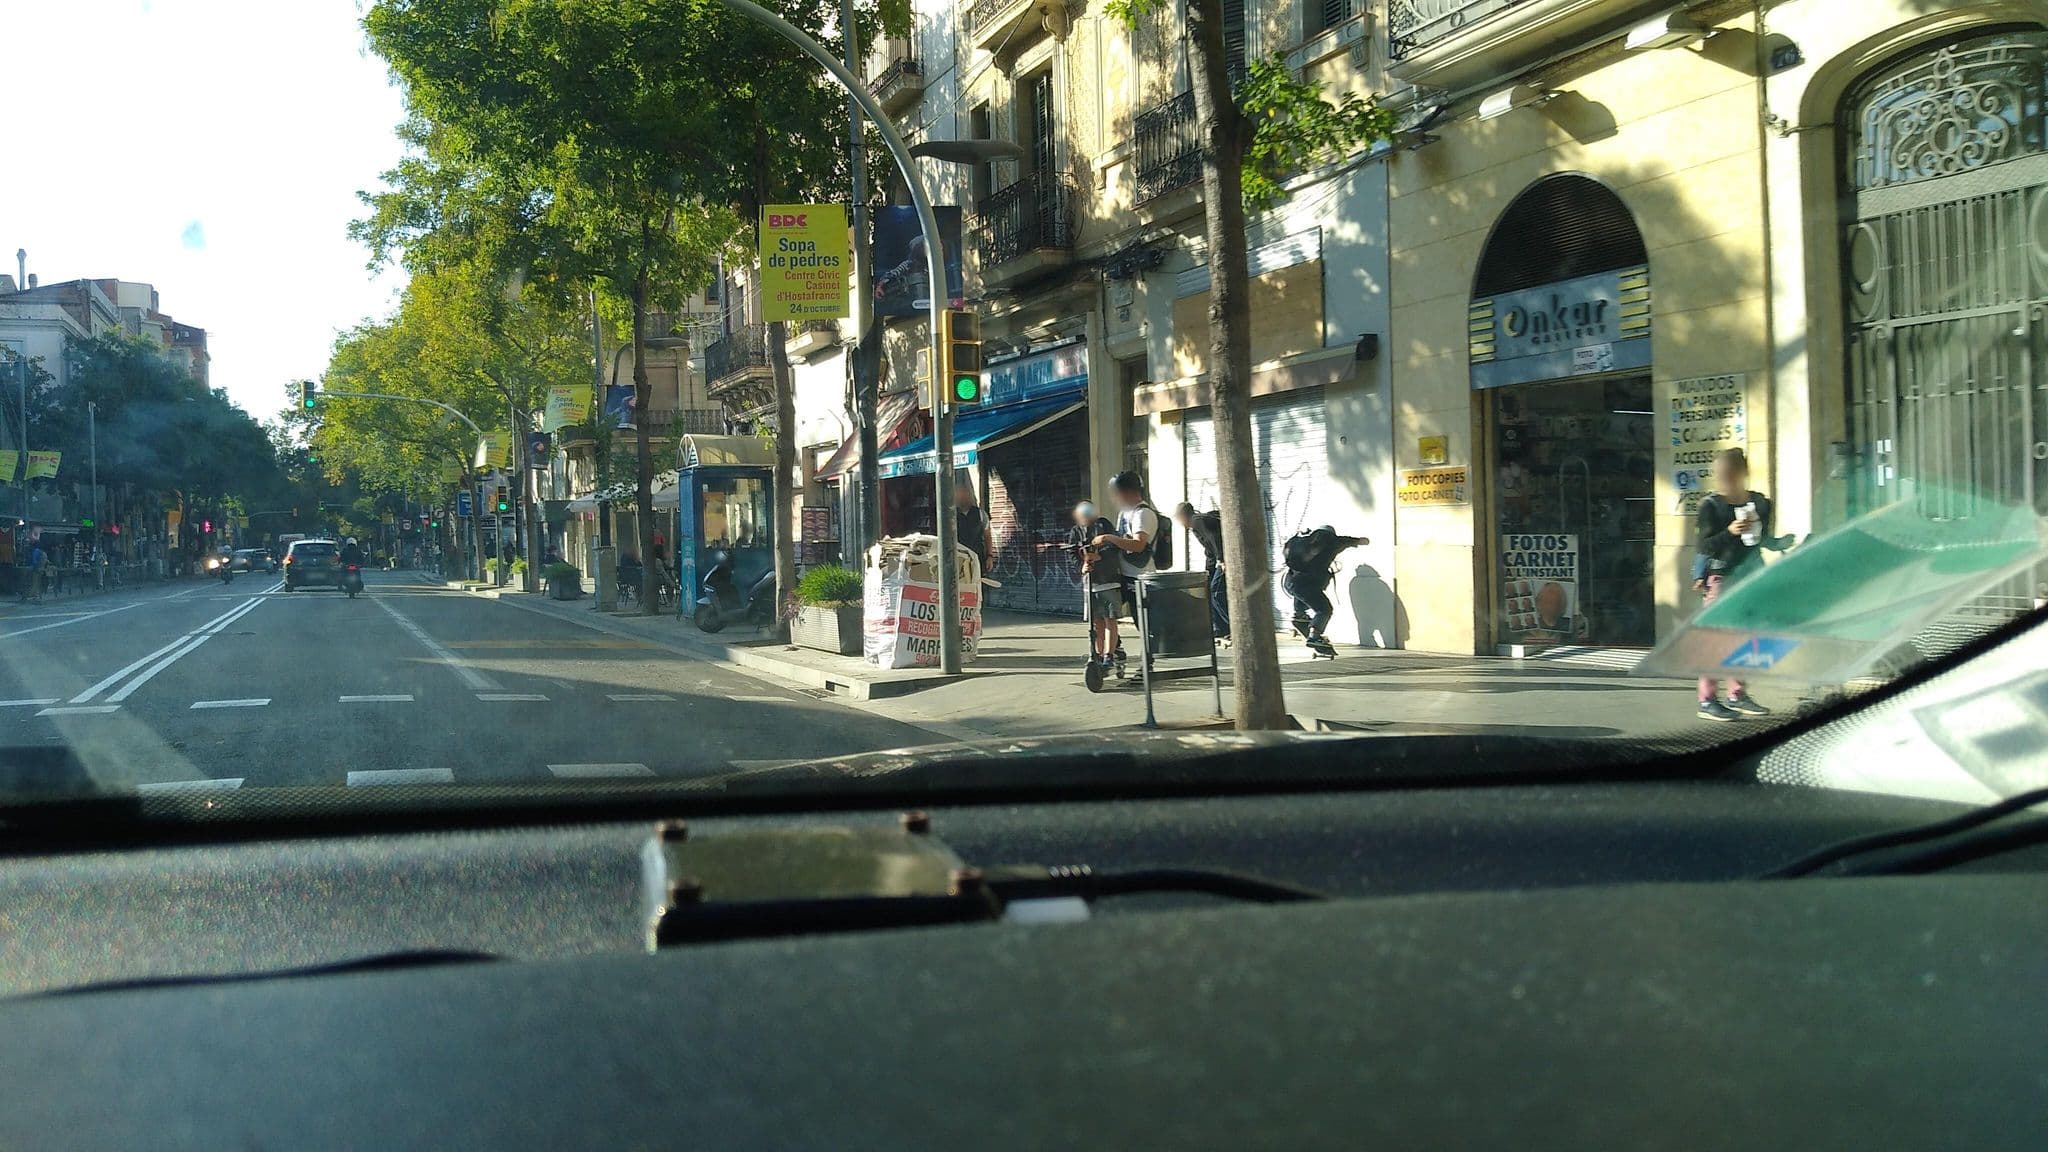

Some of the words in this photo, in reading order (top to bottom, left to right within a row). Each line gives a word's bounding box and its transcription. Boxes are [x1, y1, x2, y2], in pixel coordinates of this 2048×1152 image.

[768, 214, 808, 228] BDC
[779, 238, 816, 254] Sopa
[768, 253, 786, 267] de
[790, 253, 840, 269] pedres
[784, 270, 816, 280] Centre
[806, 280, 840, 290] Casinet
[789, 303, 802, 313] 24
[1503, 294, 1608, 337] Onkar
[1678, 376, 1735, 394] MANDOS
[1693, 392, 1742, 406] PARKING
[1674, 450, 1721, 465] ACCESS
[1408, 472, 1465, 486] FOTOCOPIES
[1398, 491, 1420, 502] FOTO
[1422, 489, 1454, 500] CARNET
[1510, 535, 1569, 551] FOTOS
[1503, 552, 1576, 567] CARNET
[1517, 568, 1575, 577] L'INSTANT
[910, 601, 936, 621] LOS
